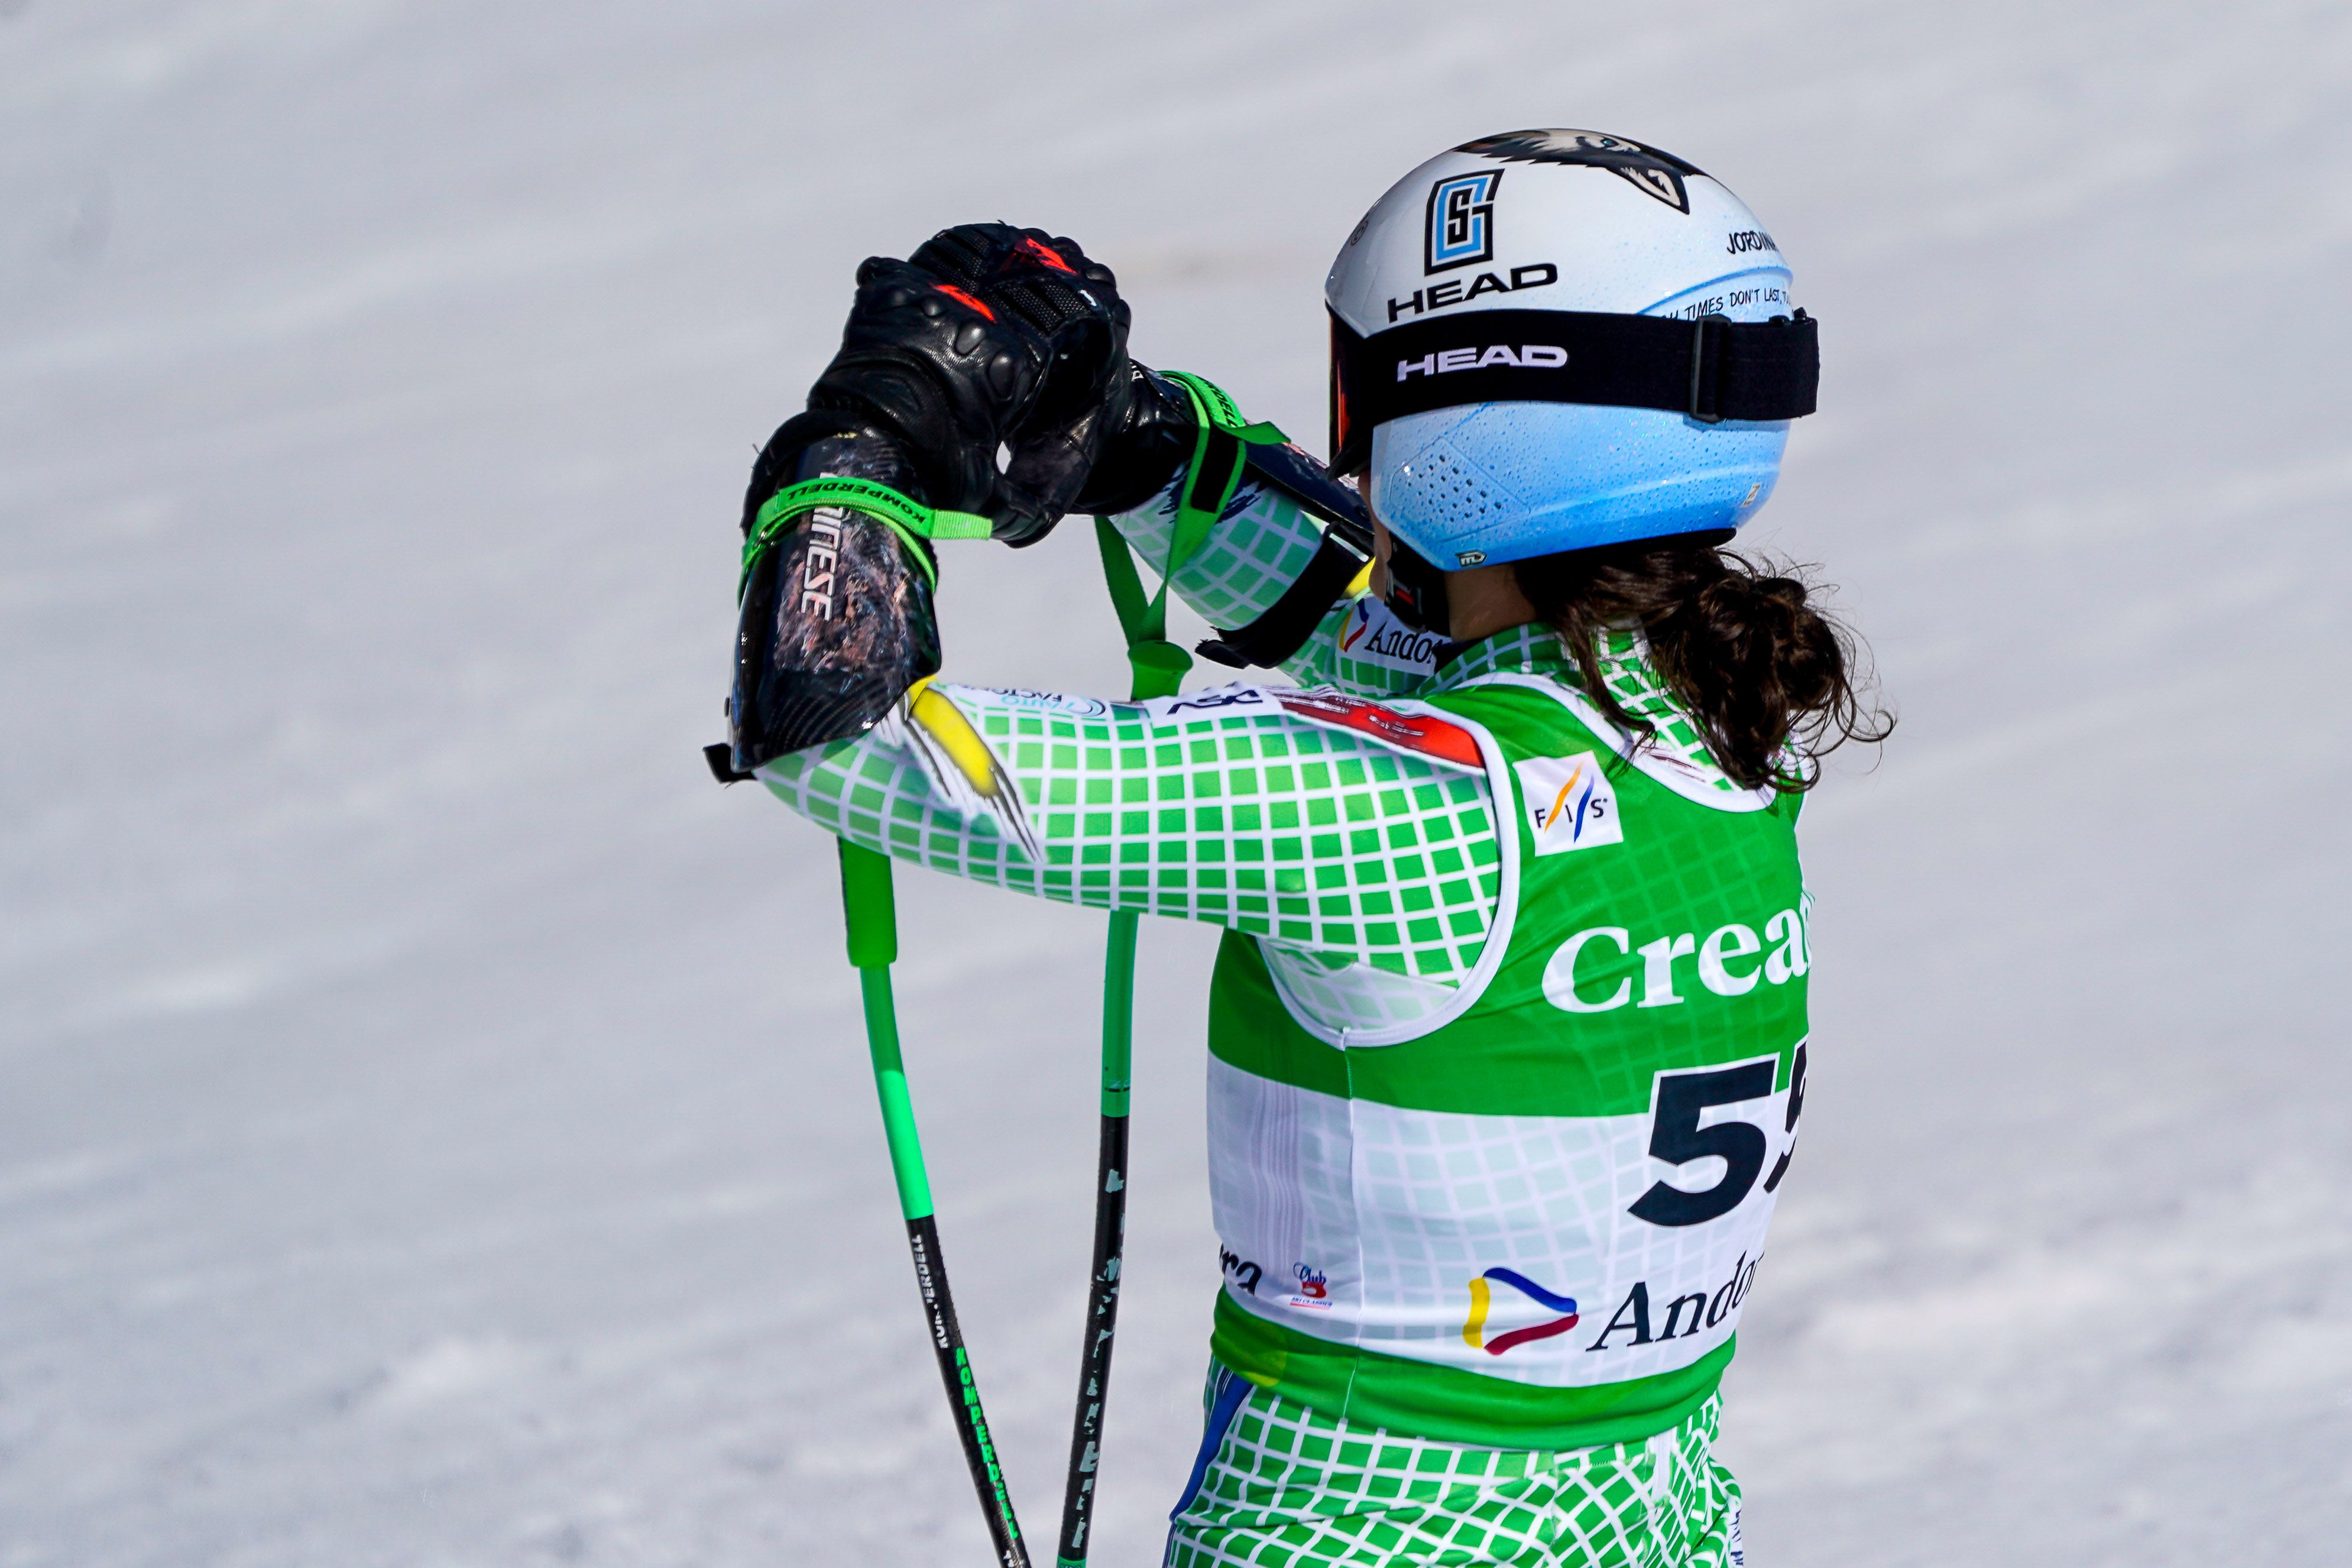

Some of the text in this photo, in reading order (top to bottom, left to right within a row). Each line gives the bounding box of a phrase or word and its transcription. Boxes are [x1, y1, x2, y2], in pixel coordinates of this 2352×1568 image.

[1388, 263, 1557, 323] HEAD
[1684, 296, 1723, 320] TIMES
[1730, 289, 1760, 307] DON'T
[1397, 345, 1568, 382] HEAD
[788, 483, 926, 523] KOMPERDELL
[801, 473, 844, 621] INESE
[1534, 798, 1605, 828] FIS
[1541, 892, 1812, 1013] Crea
